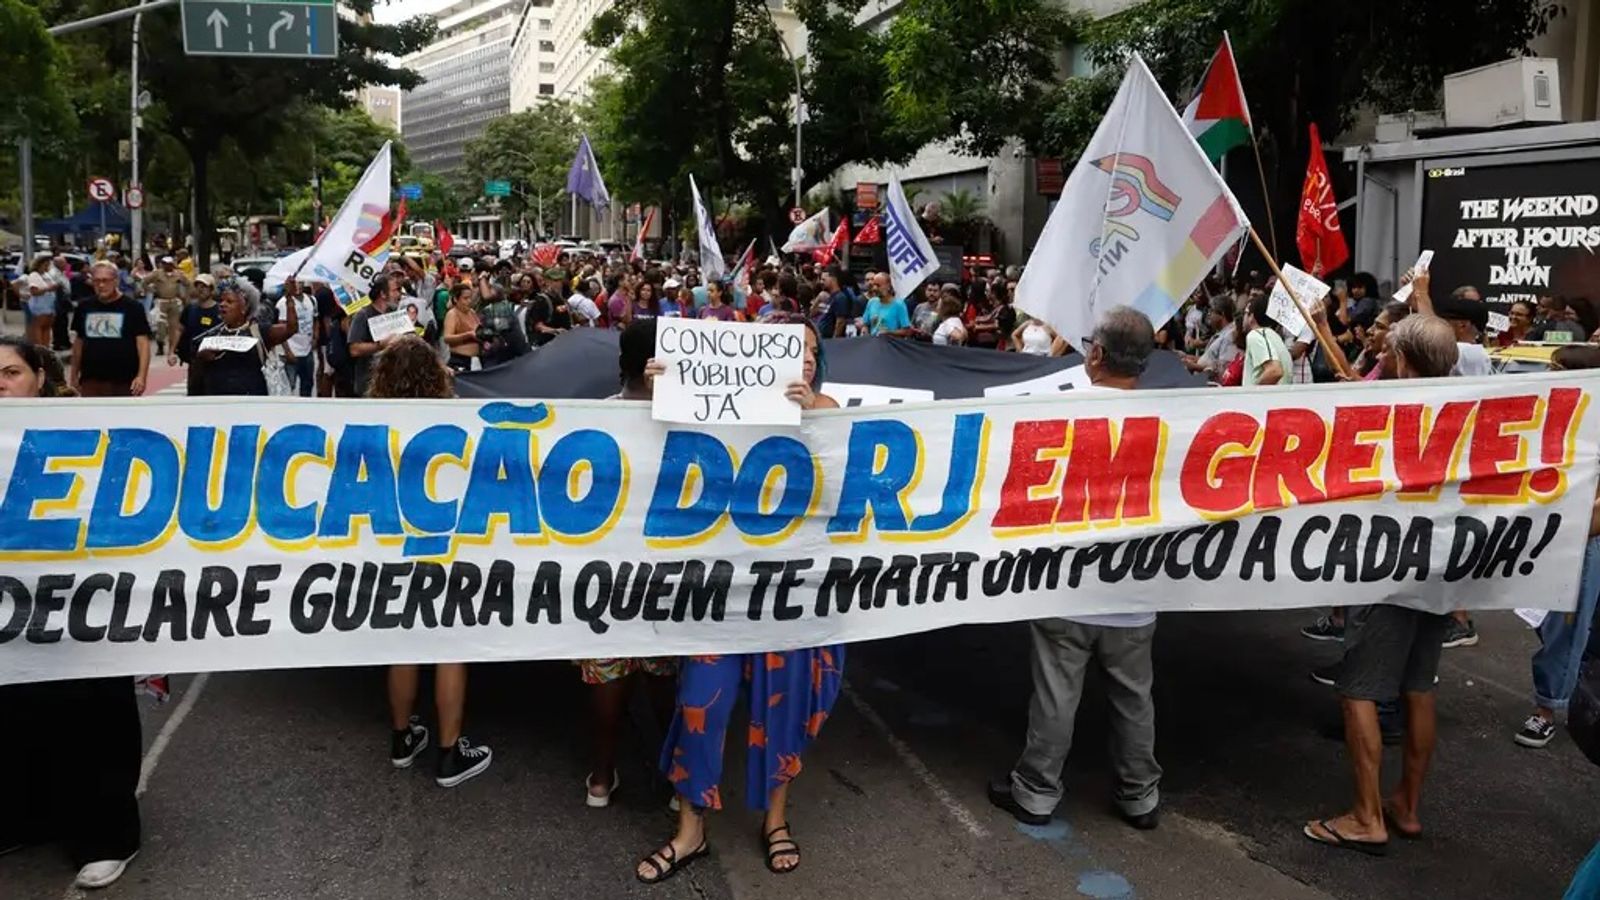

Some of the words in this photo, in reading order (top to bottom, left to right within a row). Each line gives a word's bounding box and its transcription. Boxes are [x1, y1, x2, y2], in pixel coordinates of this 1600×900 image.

[1460, 200, 1500, 219] THE
[1502, 194, 1599, 222] WEEKND
[1452, 227, 1518, 248] AFTER
[1521, 225, 1600, 255] HOURS
[1505, 246, 1537, 266] TIL
[1488, 265, 1551, 288] DAWN
[1498, 293, 1538, 304] ANITTA
[660, 326, 801, 360] CONCURSO
[677, 358, 776, 387] PÚBLICO
[694, 387, 745, 421] JÁ
[0, 401, 631, 562] EDUCAÇÃO
[644, 430, 823, 548] DO
[827, 412, 990, 544] RJ
[991, 416, 1168, 537] EM
[1179, 387, 1589, 521] GREVE!
[0, 564, 281, 644] DECLARE
[289, 560, 515, 632] GUERRA
[526, 561, 562, 625] A
[573, 559, 735, 634] QUEM
[746, 558, 814, 621] TE
[813, 552, 979, 616] MATA
[1064, 520, 1240, 589] POUCO
[1238, 516, 1283, 580] A
[1291, 512, 1435, 584] CADA
[1442, 512, 1562, 581] DIA!
